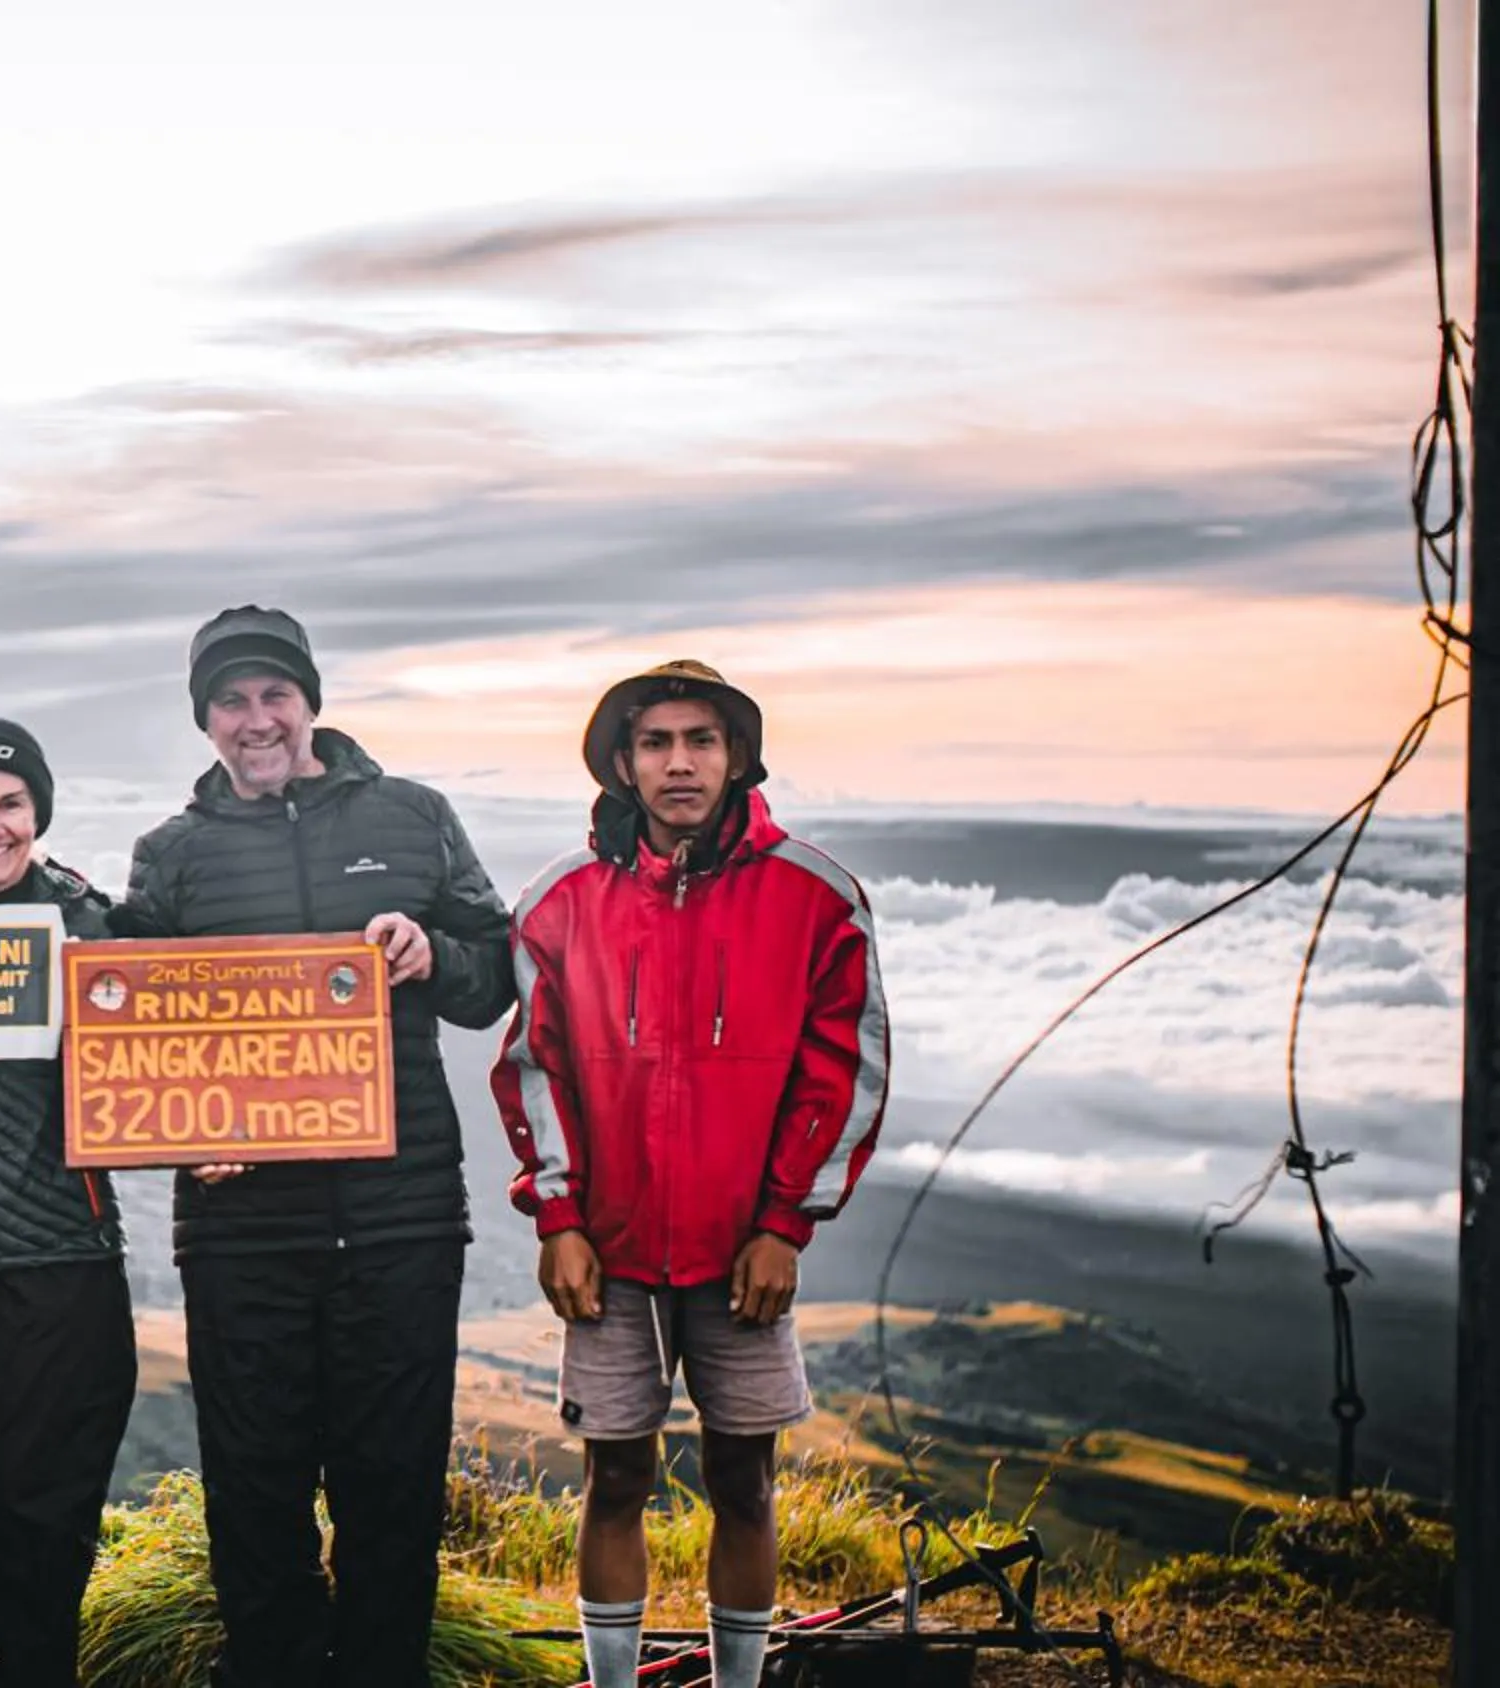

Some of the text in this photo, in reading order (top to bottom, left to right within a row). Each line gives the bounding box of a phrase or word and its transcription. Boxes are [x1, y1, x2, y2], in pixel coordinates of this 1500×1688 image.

[193, 960, 306, 983] Summit
[135, 988, 315, 1020] RINJANI
[81, 1032, 375, 1082] SANGKAREANG
[81, 1080, 376, 1142] 3200 masl
